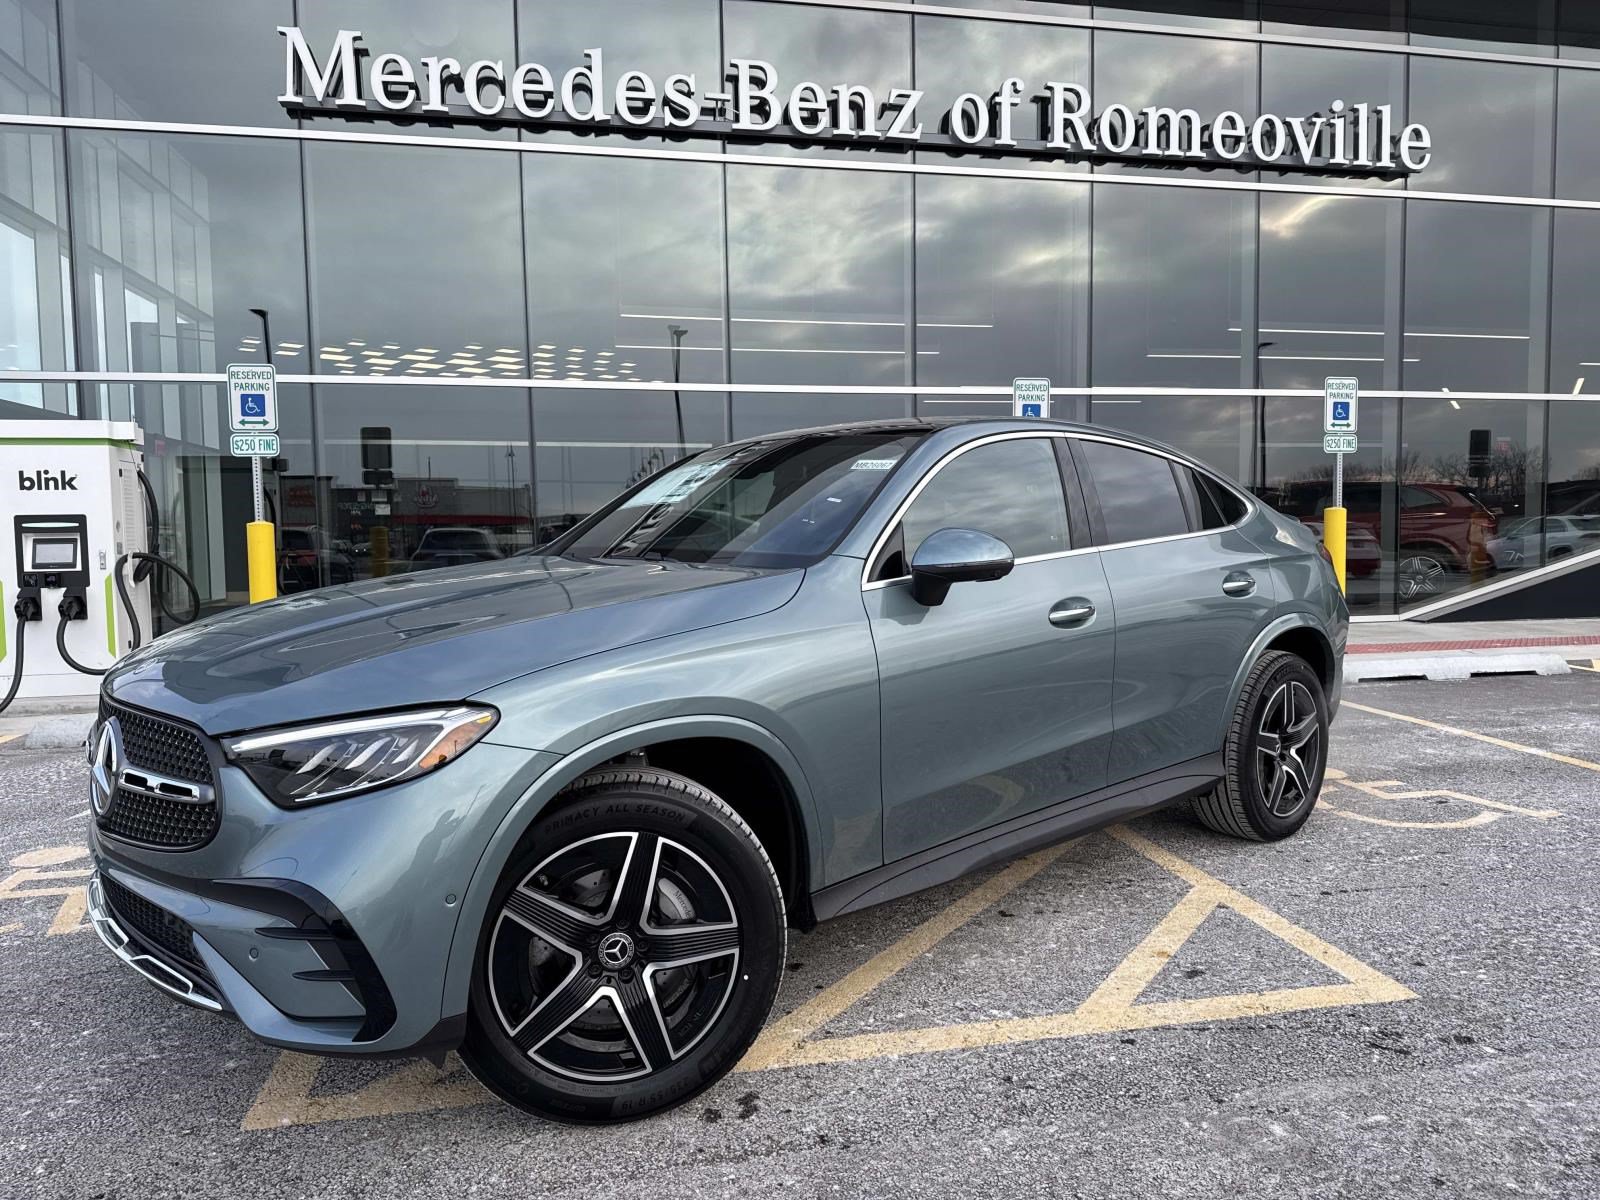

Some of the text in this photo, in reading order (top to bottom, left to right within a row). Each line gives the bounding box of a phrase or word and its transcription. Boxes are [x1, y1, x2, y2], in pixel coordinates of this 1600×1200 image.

[277, 26, 1432, 170] Mercedes-Benz of Romeoville
[230, 371, 271, 379] RESERVED
[234, 383, 269, 391] PARKING
[1329, 392, 1354, 400] PARKING
[234, 439, 276, 451] $250 FINE
[1326, 438, 1355, 449] $250 FINE
[18, 469, 79, 491] blink
[544, 803, 686, 833] PRIMACY ALL SEASON
